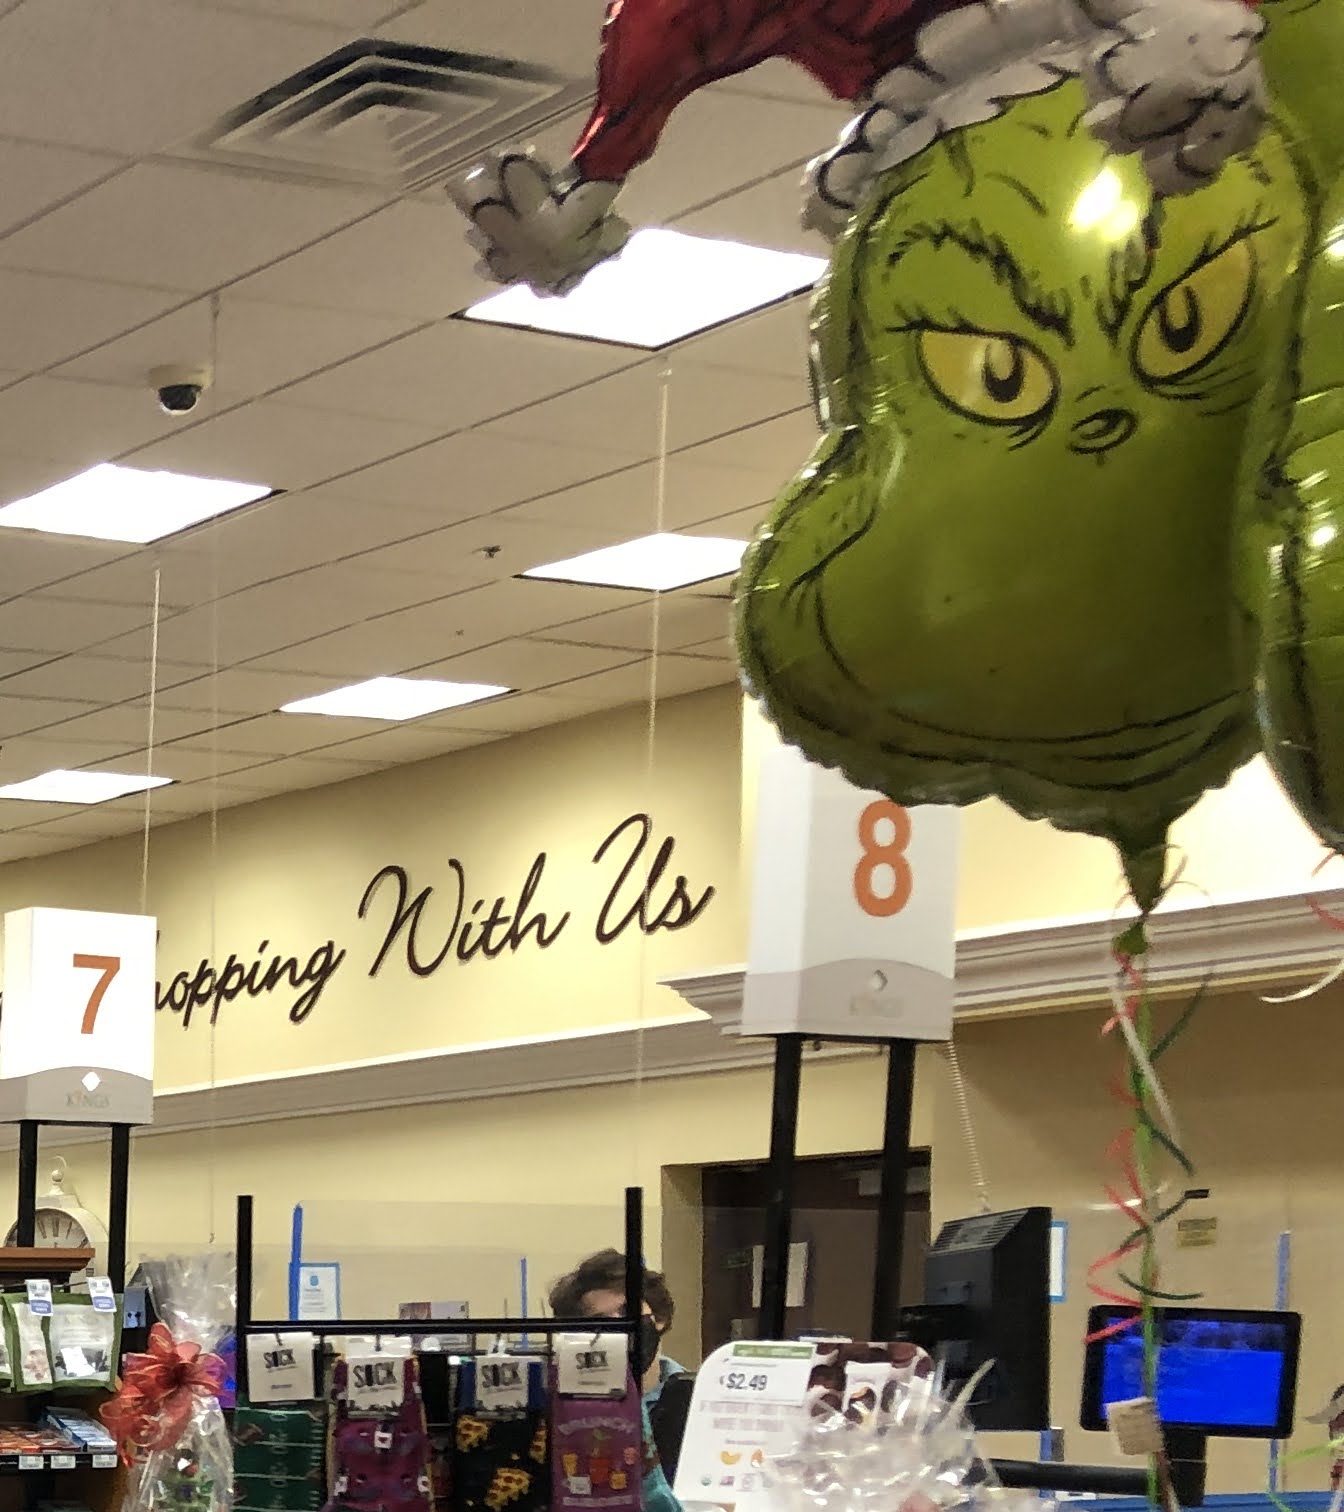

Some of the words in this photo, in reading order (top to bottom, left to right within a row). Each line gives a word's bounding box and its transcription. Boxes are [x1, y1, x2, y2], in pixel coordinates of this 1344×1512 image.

[854, 799, 913, 917] 8
[155, 930, 346, 1029] opping
[358, 852, 570, 978] With
[592, 813, 716, 946] Us
[73, 953, 120, 1034] 7
[726, 1373, 767, 1391] $2.49
